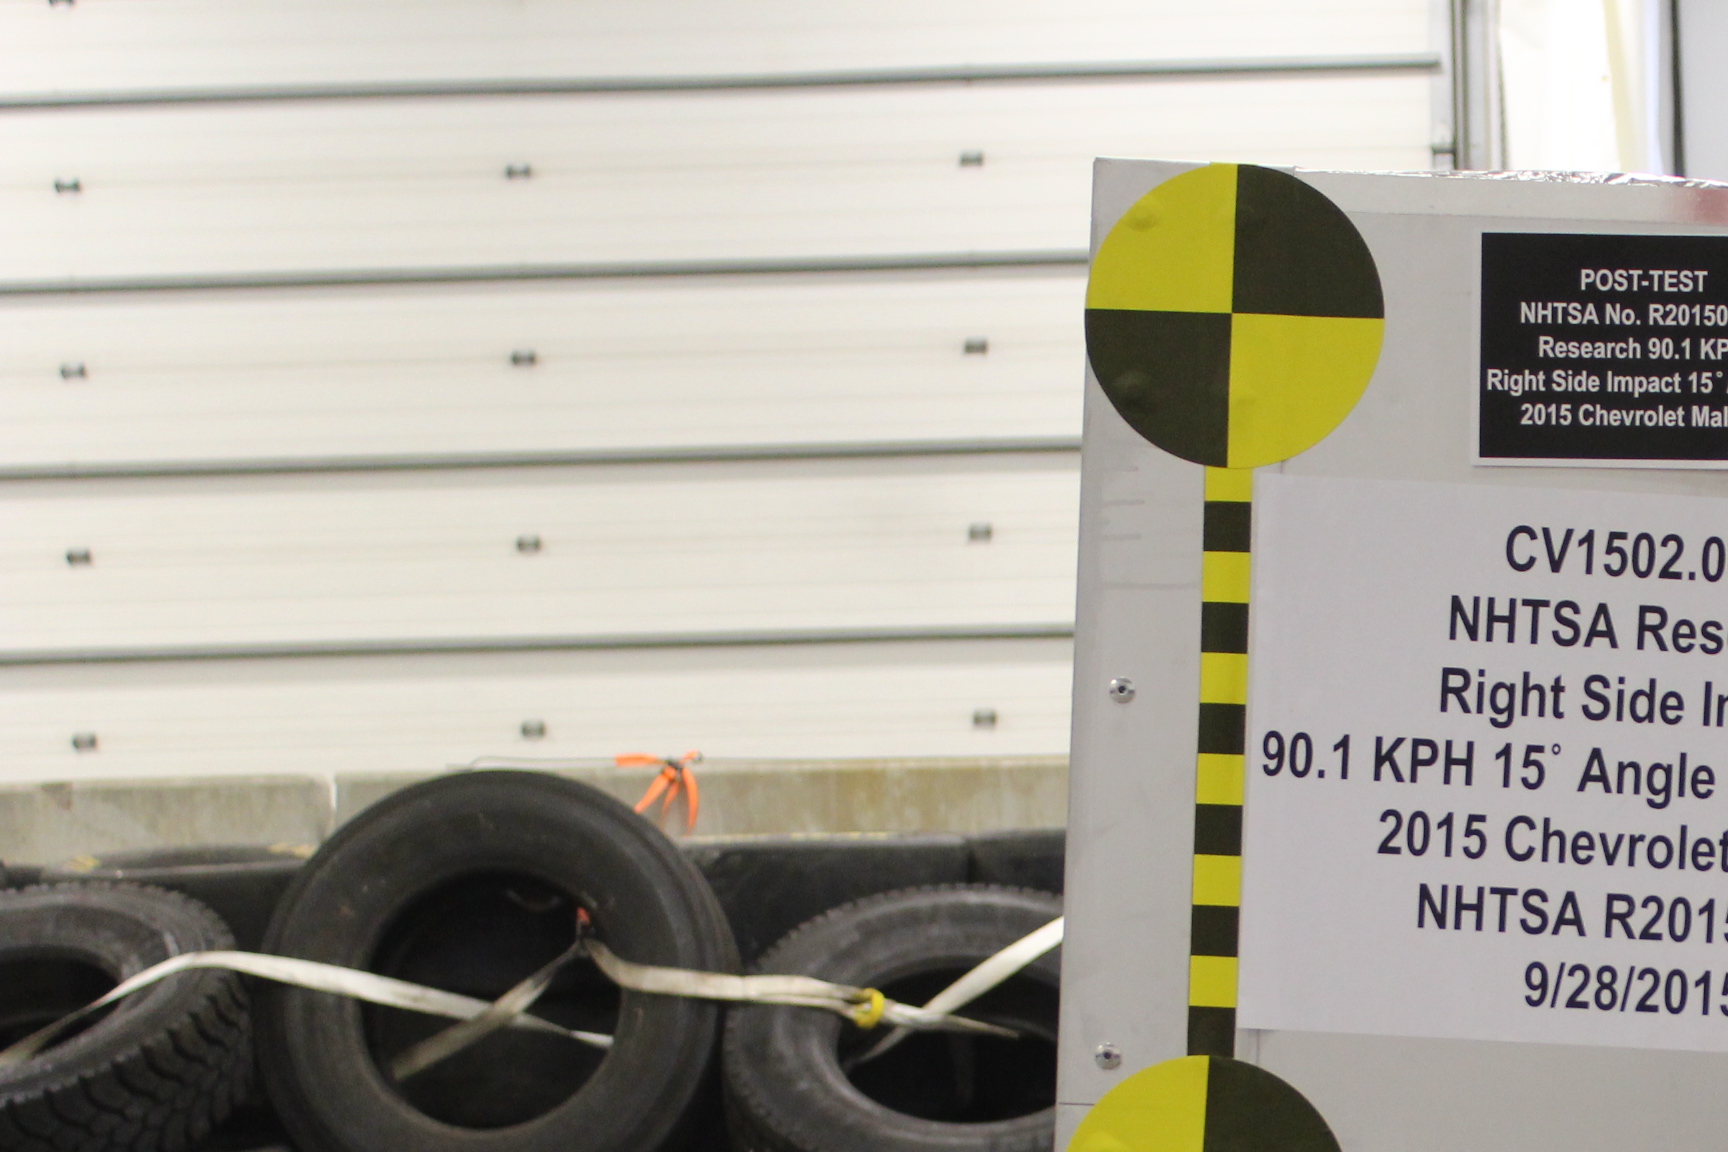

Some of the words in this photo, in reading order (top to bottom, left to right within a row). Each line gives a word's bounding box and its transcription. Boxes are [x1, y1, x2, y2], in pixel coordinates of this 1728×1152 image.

[1581, 269, 1708, 292] POST-TEST
[1521, 302, 1599, 324] NHTSA
[1606, 304, 1640, 325] No.
[1539, 336, 1640, 358] Research
[1649, 338, 1690, 359] 90.1
[1488, 369, 1545, 396] Right
[1552, 370, 1600, 392] Side
[1608, 371, 1681, 397] Impact
[1521, 404, 1571, 425] 2015
[1579, 404, 1684, 426] Chevrolet
[1449, 595, 1618, 649] NHTSA
[1440, 667, 1565, 728] Right
[1582, 674, 1684, 725] Side
[1263, 731, 1350, 779] 90.1
[1374, 736, 1474, 786] KPH
[1577, 748, 1715, 809] Angle
[1377, 809, 1487, 859] 2015
[1418, 883, 1586, 936] NHTSA
